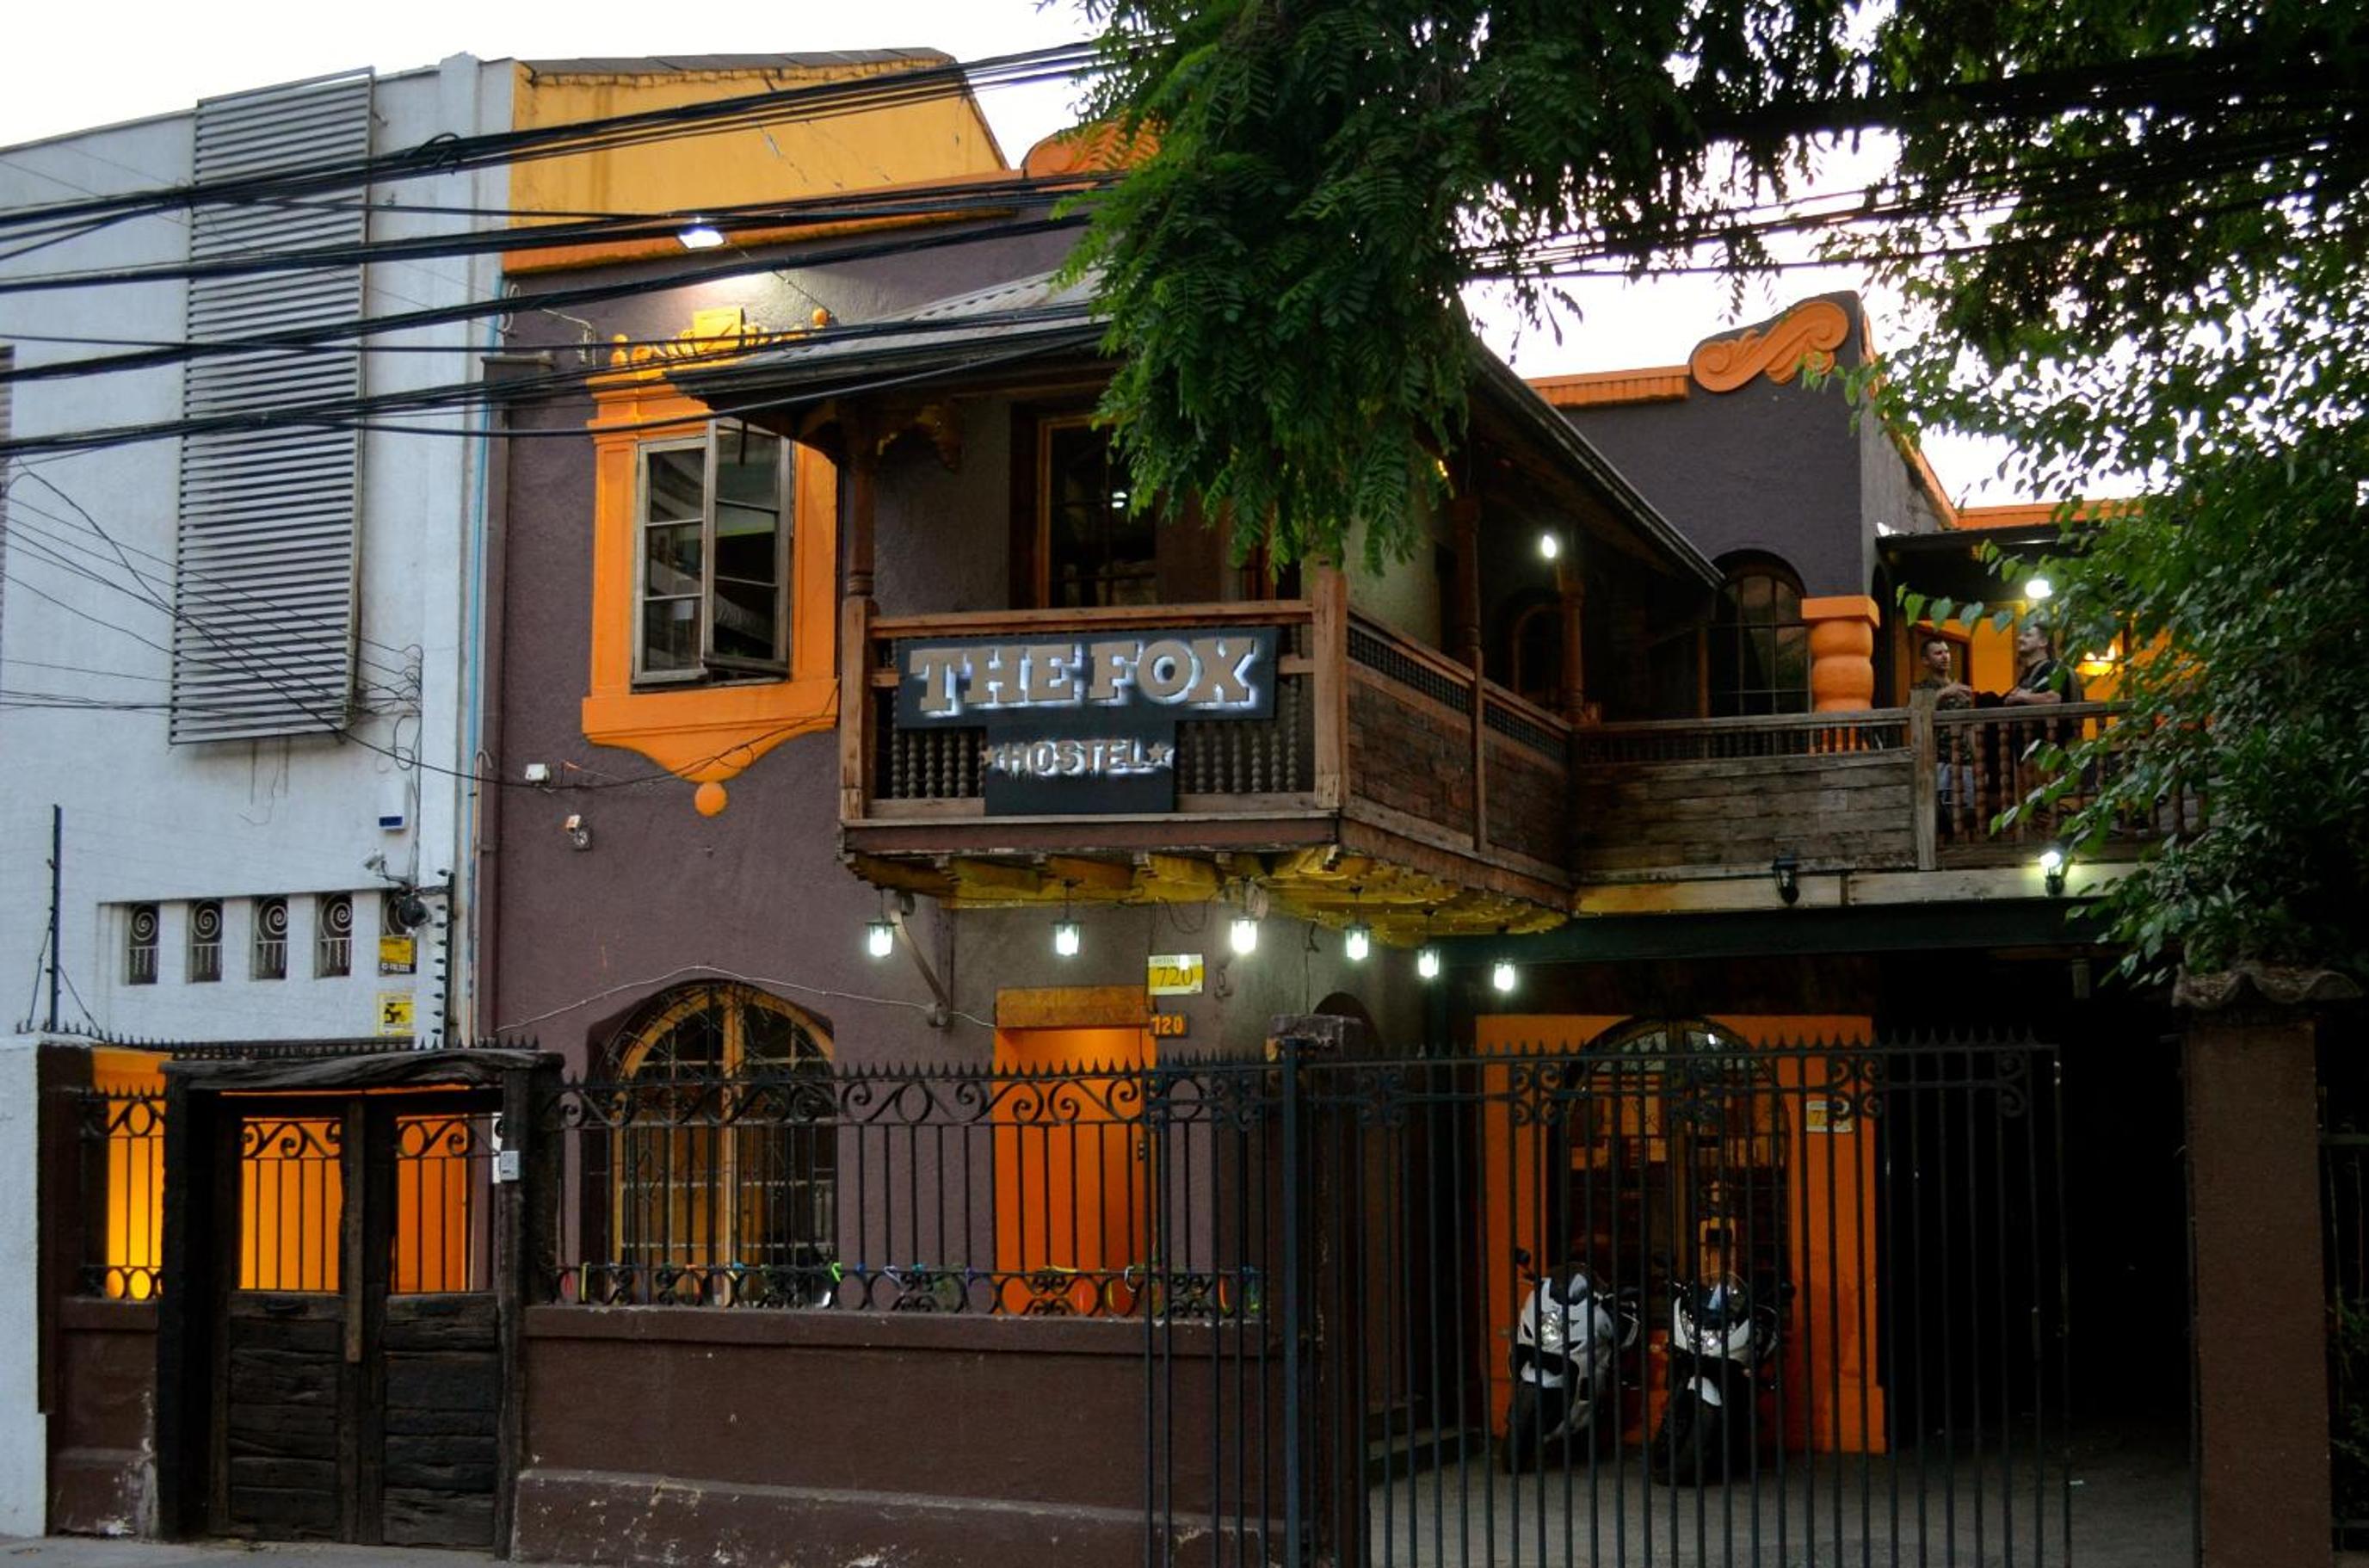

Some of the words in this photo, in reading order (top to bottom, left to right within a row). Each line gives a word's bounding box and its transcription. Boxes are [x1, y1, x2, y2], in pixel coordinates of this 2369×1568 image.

[909, 644, 1079, 713] THE
[1089, 638, 1255, 707] FOX
[1002, 738, 1150, 776] HOSTEL
[1157, 966, 1194, 987] 720
